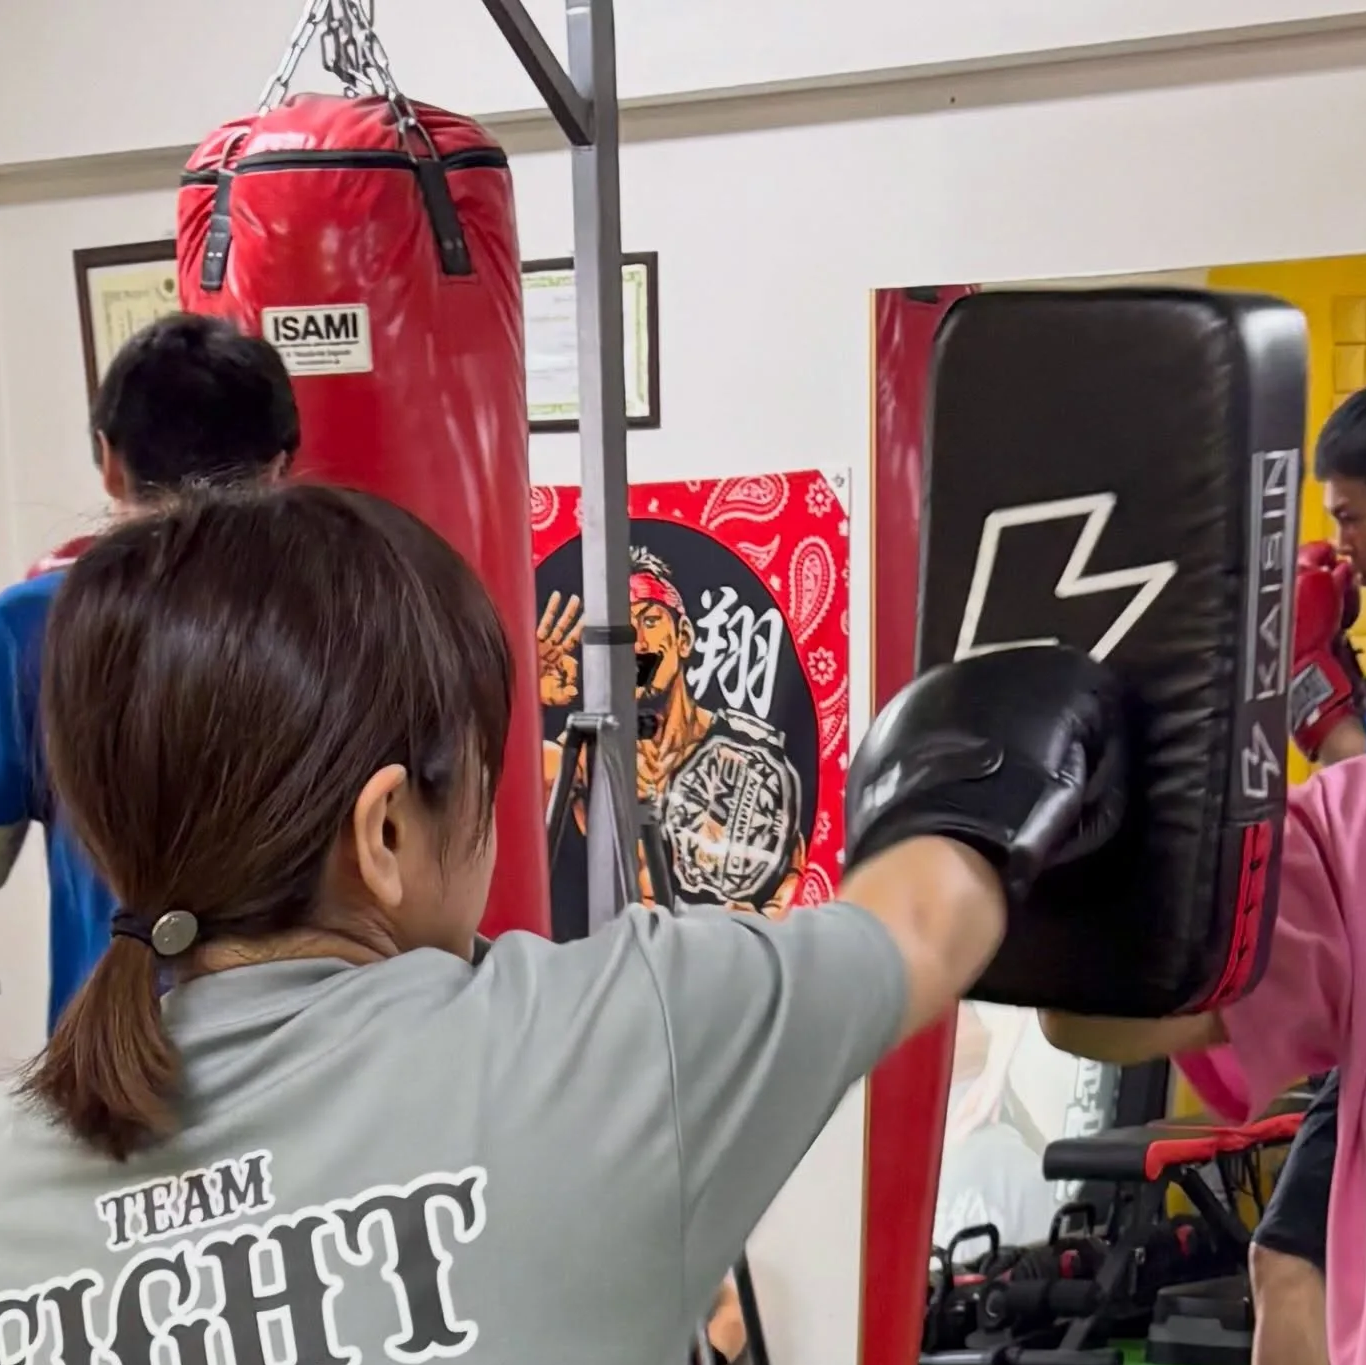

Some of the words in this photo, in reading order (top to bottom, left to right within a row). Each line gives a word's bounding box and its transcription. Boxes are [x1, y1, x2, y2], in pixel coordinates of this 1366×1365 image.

[273, 312, 358, 341] ISAMI
[686, 586, 784, 720] 翔
[731, 778, 758, 870] CAMPION
[98, 1151, 273, 1250] TEAM
